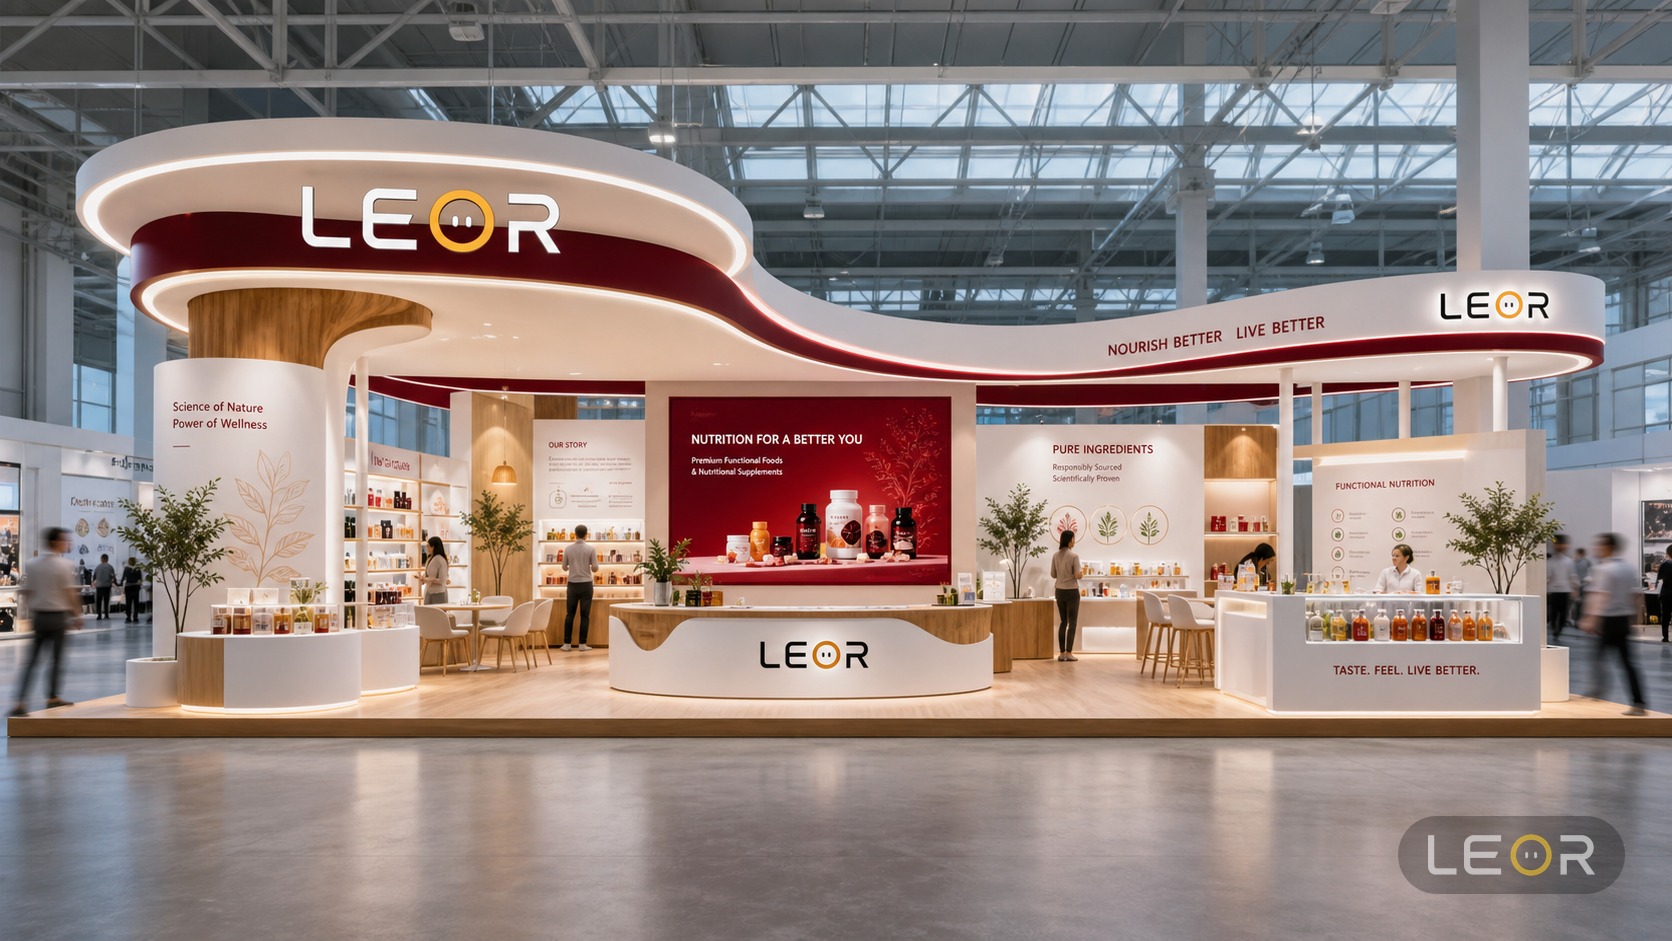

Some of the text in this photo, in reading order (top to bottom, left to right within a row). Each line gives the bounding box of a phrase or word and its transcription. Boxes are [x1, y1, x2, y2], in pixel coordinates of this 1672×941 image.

[302, 186, 561, 254] LEOR
[1440, 290, 1550, 320] LEOR
[1108, 316, 1325, 356] NOURISH BETTER LIVE BETTER
[173, 401, 263, 414] Science of Nature
[172, 418, 268, 430] Power of Wellness
[548, 441, 588, 449] OUR STORY
[691, 434, 863, 445] NUTRITION FOR A BETTER YOU
[1052, 444, 1154, 454] PURE INGREDIENTS
[691, 456, 783, 465] Premium Functional Foods
[691, 467, 783, 477] & Nutritional Supplements
[1094, 463, 1122, 471] Sourced
[1052, 474, 1120, 484] Scientifically Proven
[1335, 478, 1435, 491] FUNCTIONAL NUTRITION
[760, 640, 869, 670] LEOR
[1333, 665, 1480, 675] TASTE. FEEL. LIVE BETTER.
